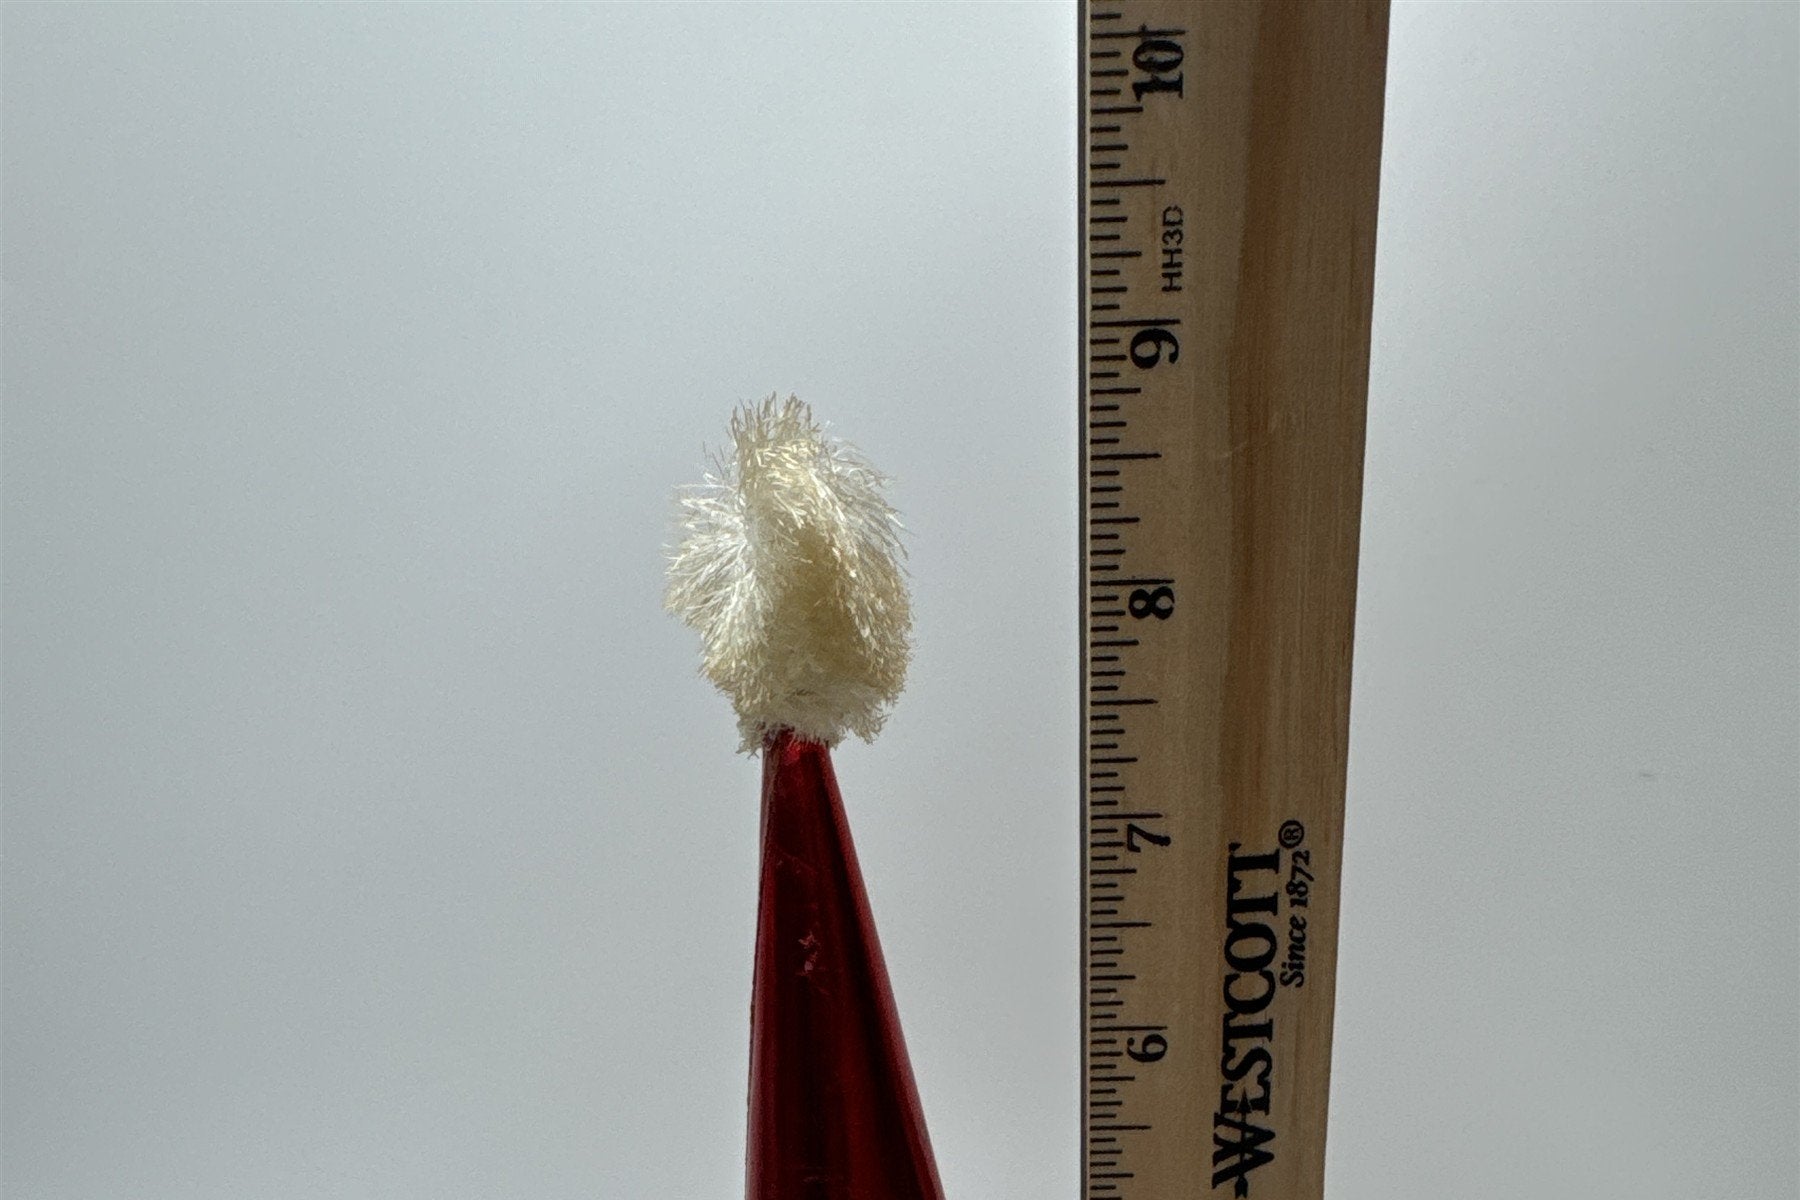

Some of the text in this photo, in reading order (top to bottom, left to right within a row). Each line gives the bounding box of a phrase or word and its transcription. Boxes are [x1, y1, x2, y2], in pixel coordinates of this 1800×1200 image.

[1132, 39, 1184, 102] 10
[1161, 204, 1184, 293] HH3D
[1129, 328, 1180, 369] 9
[1128, 586, 1175, 620] 8
[1126, 823, 1172, 853] 7
[1280, 849, 1315, 988] Since 1872
[1212, 842, 1281, 1190] WESTCOTT
[1126, 1033, 1168, 1063] 6
